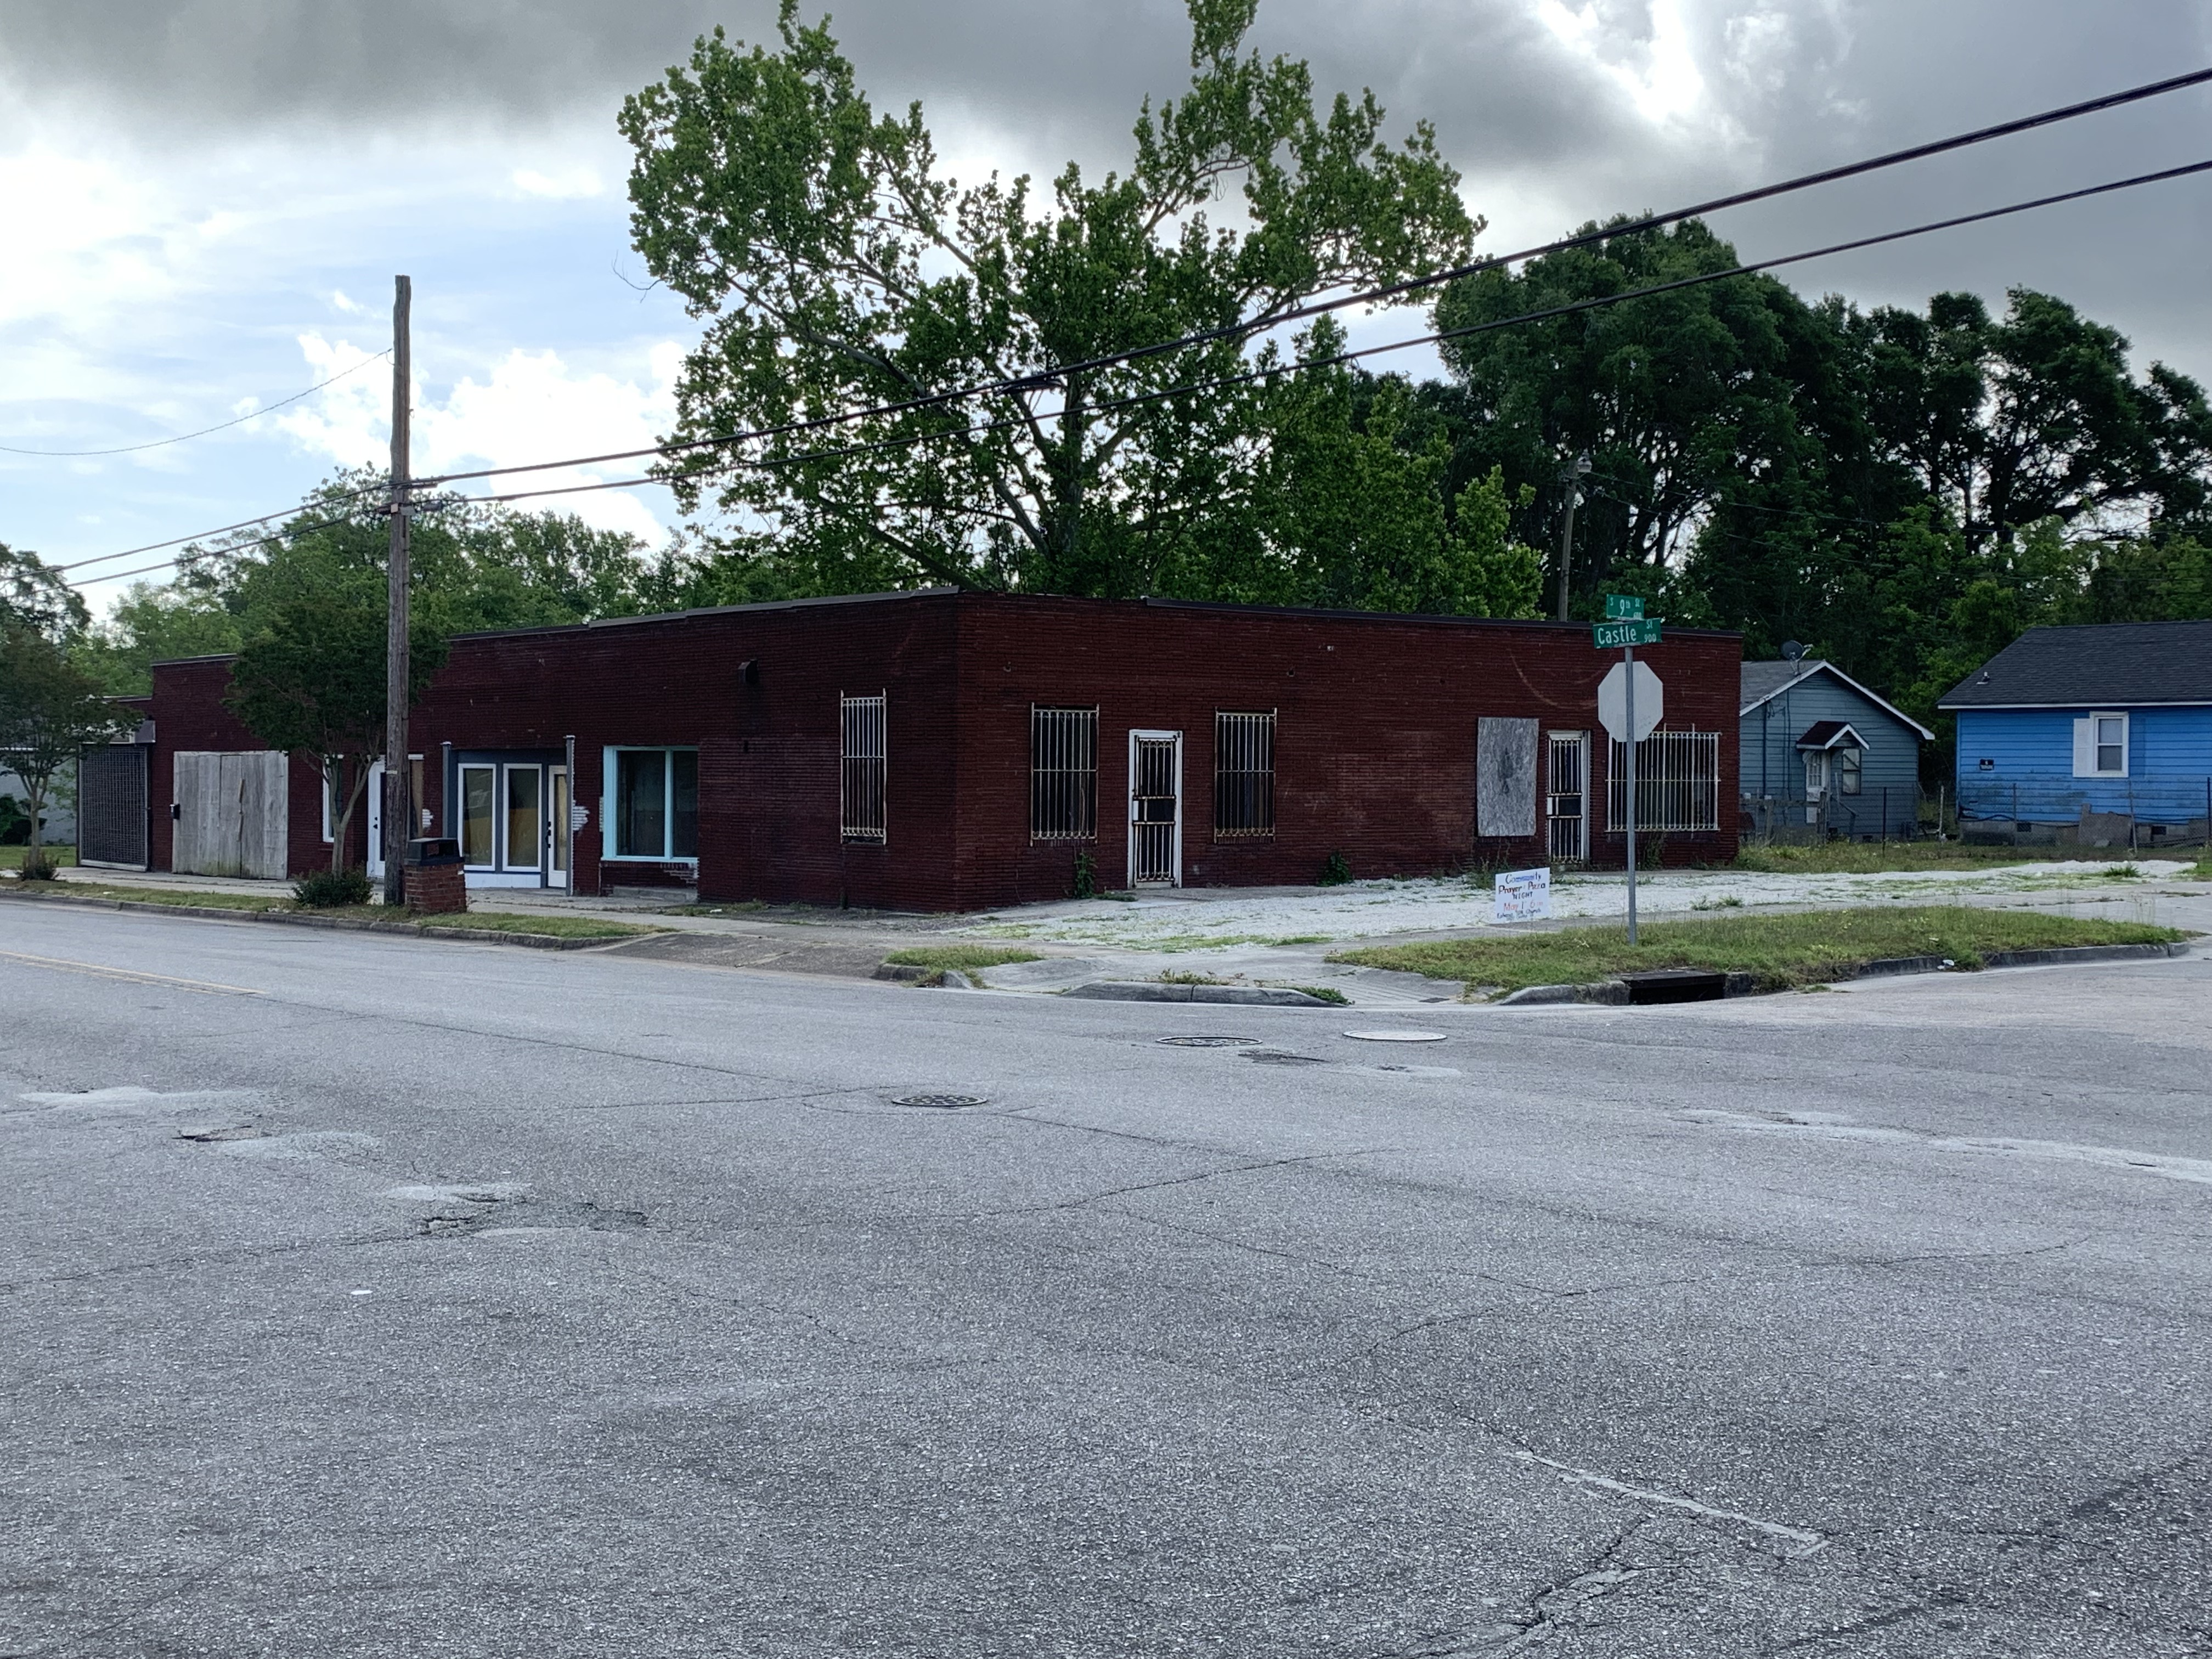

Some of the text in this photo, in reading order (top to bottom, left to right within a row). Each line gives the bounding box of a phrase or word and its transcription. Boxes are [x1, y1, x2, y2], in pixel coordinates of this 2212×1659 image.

[1610, 597, 1613, 606] S
[1620, 599, 1631, 616] 9th
[1598, 620, 1653, 644] Castle St
[1644, 634, 1657, 642] 900
